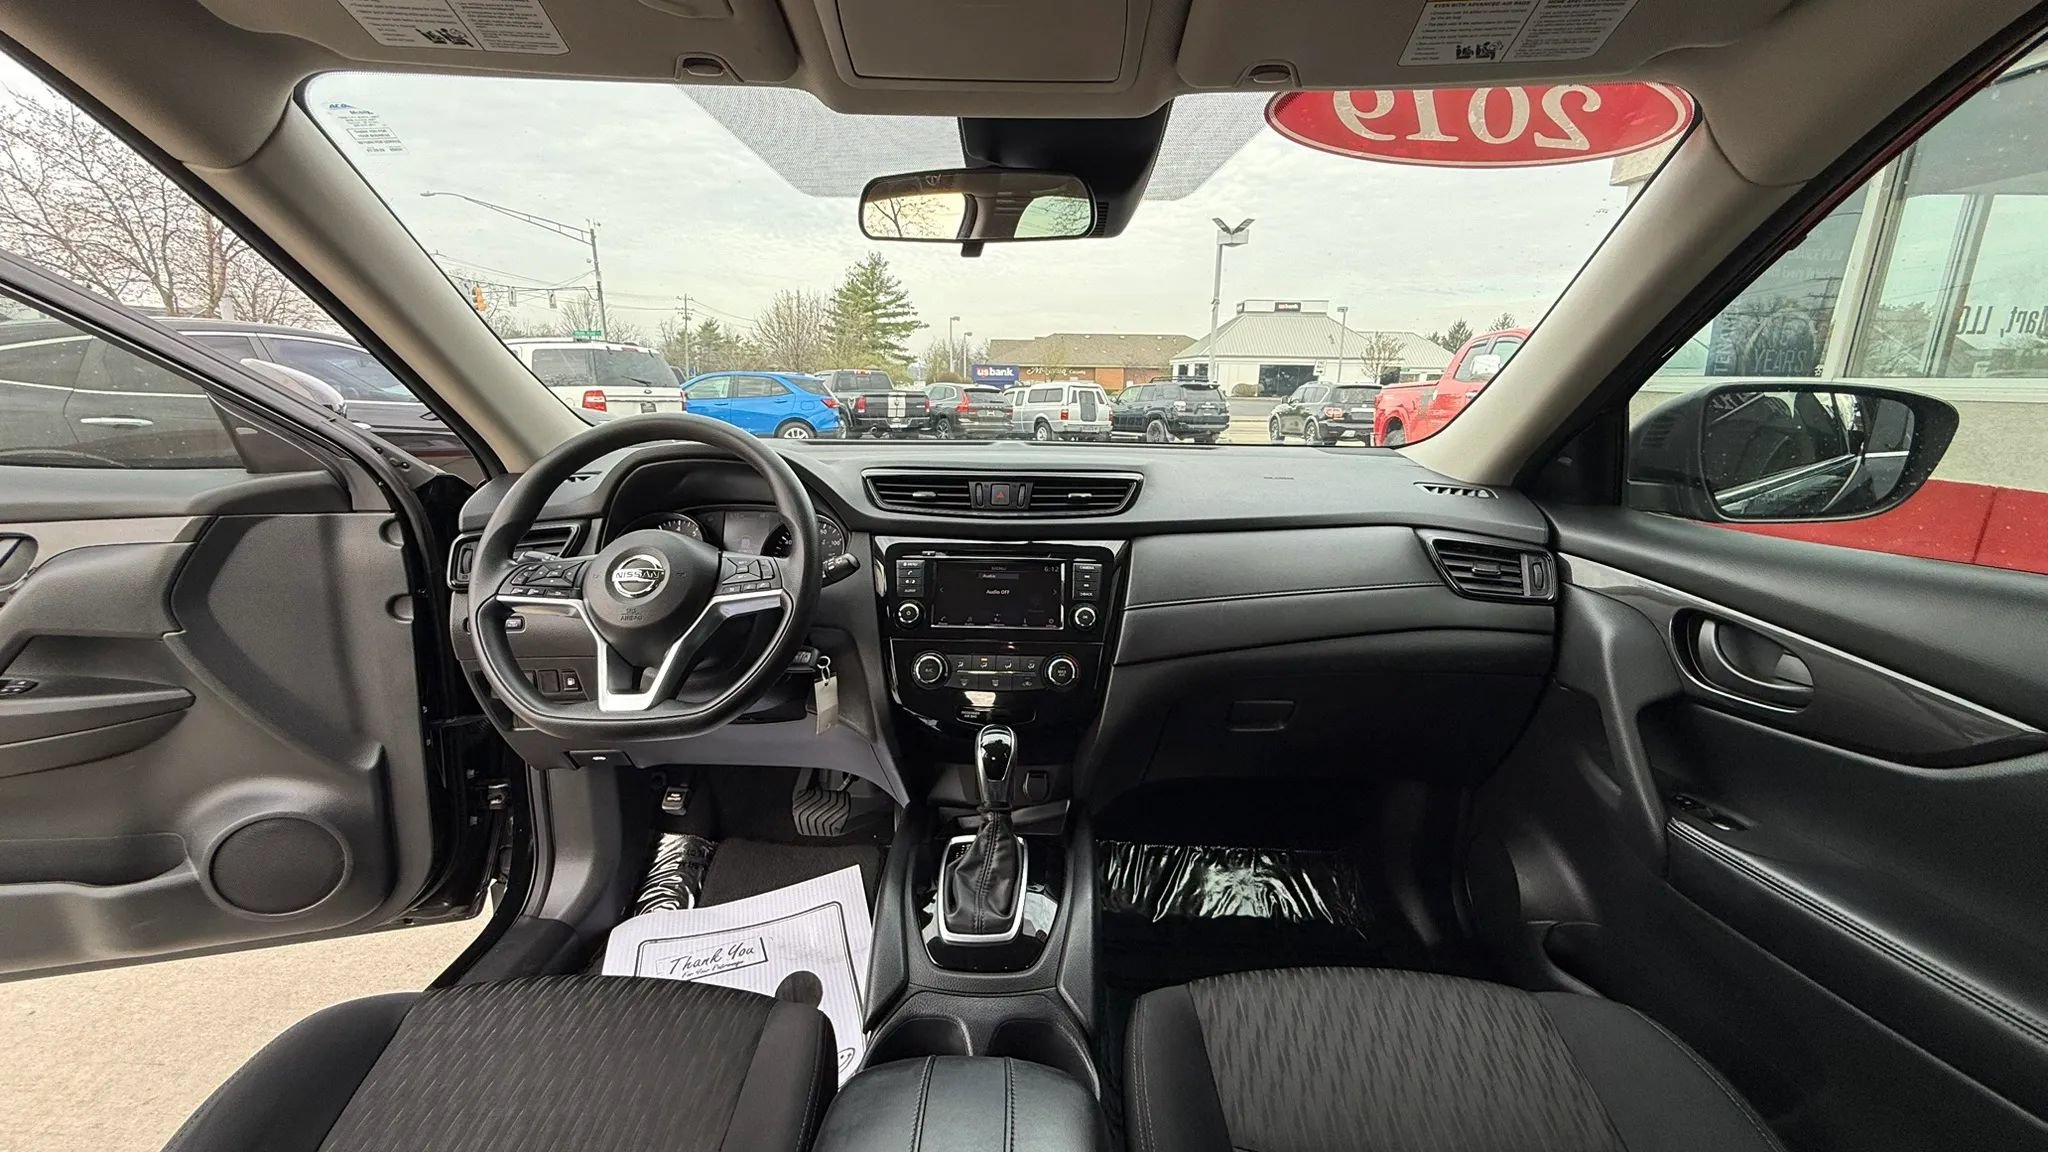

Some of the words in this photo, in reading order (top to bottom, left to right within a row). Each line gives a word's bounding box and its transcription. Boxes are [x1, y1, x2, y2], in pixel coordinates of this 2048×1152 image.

[615, 570, 660, 580] NISSAN
[669, 948, 723, 975] Thank
[728, 942, 755, 960] You
